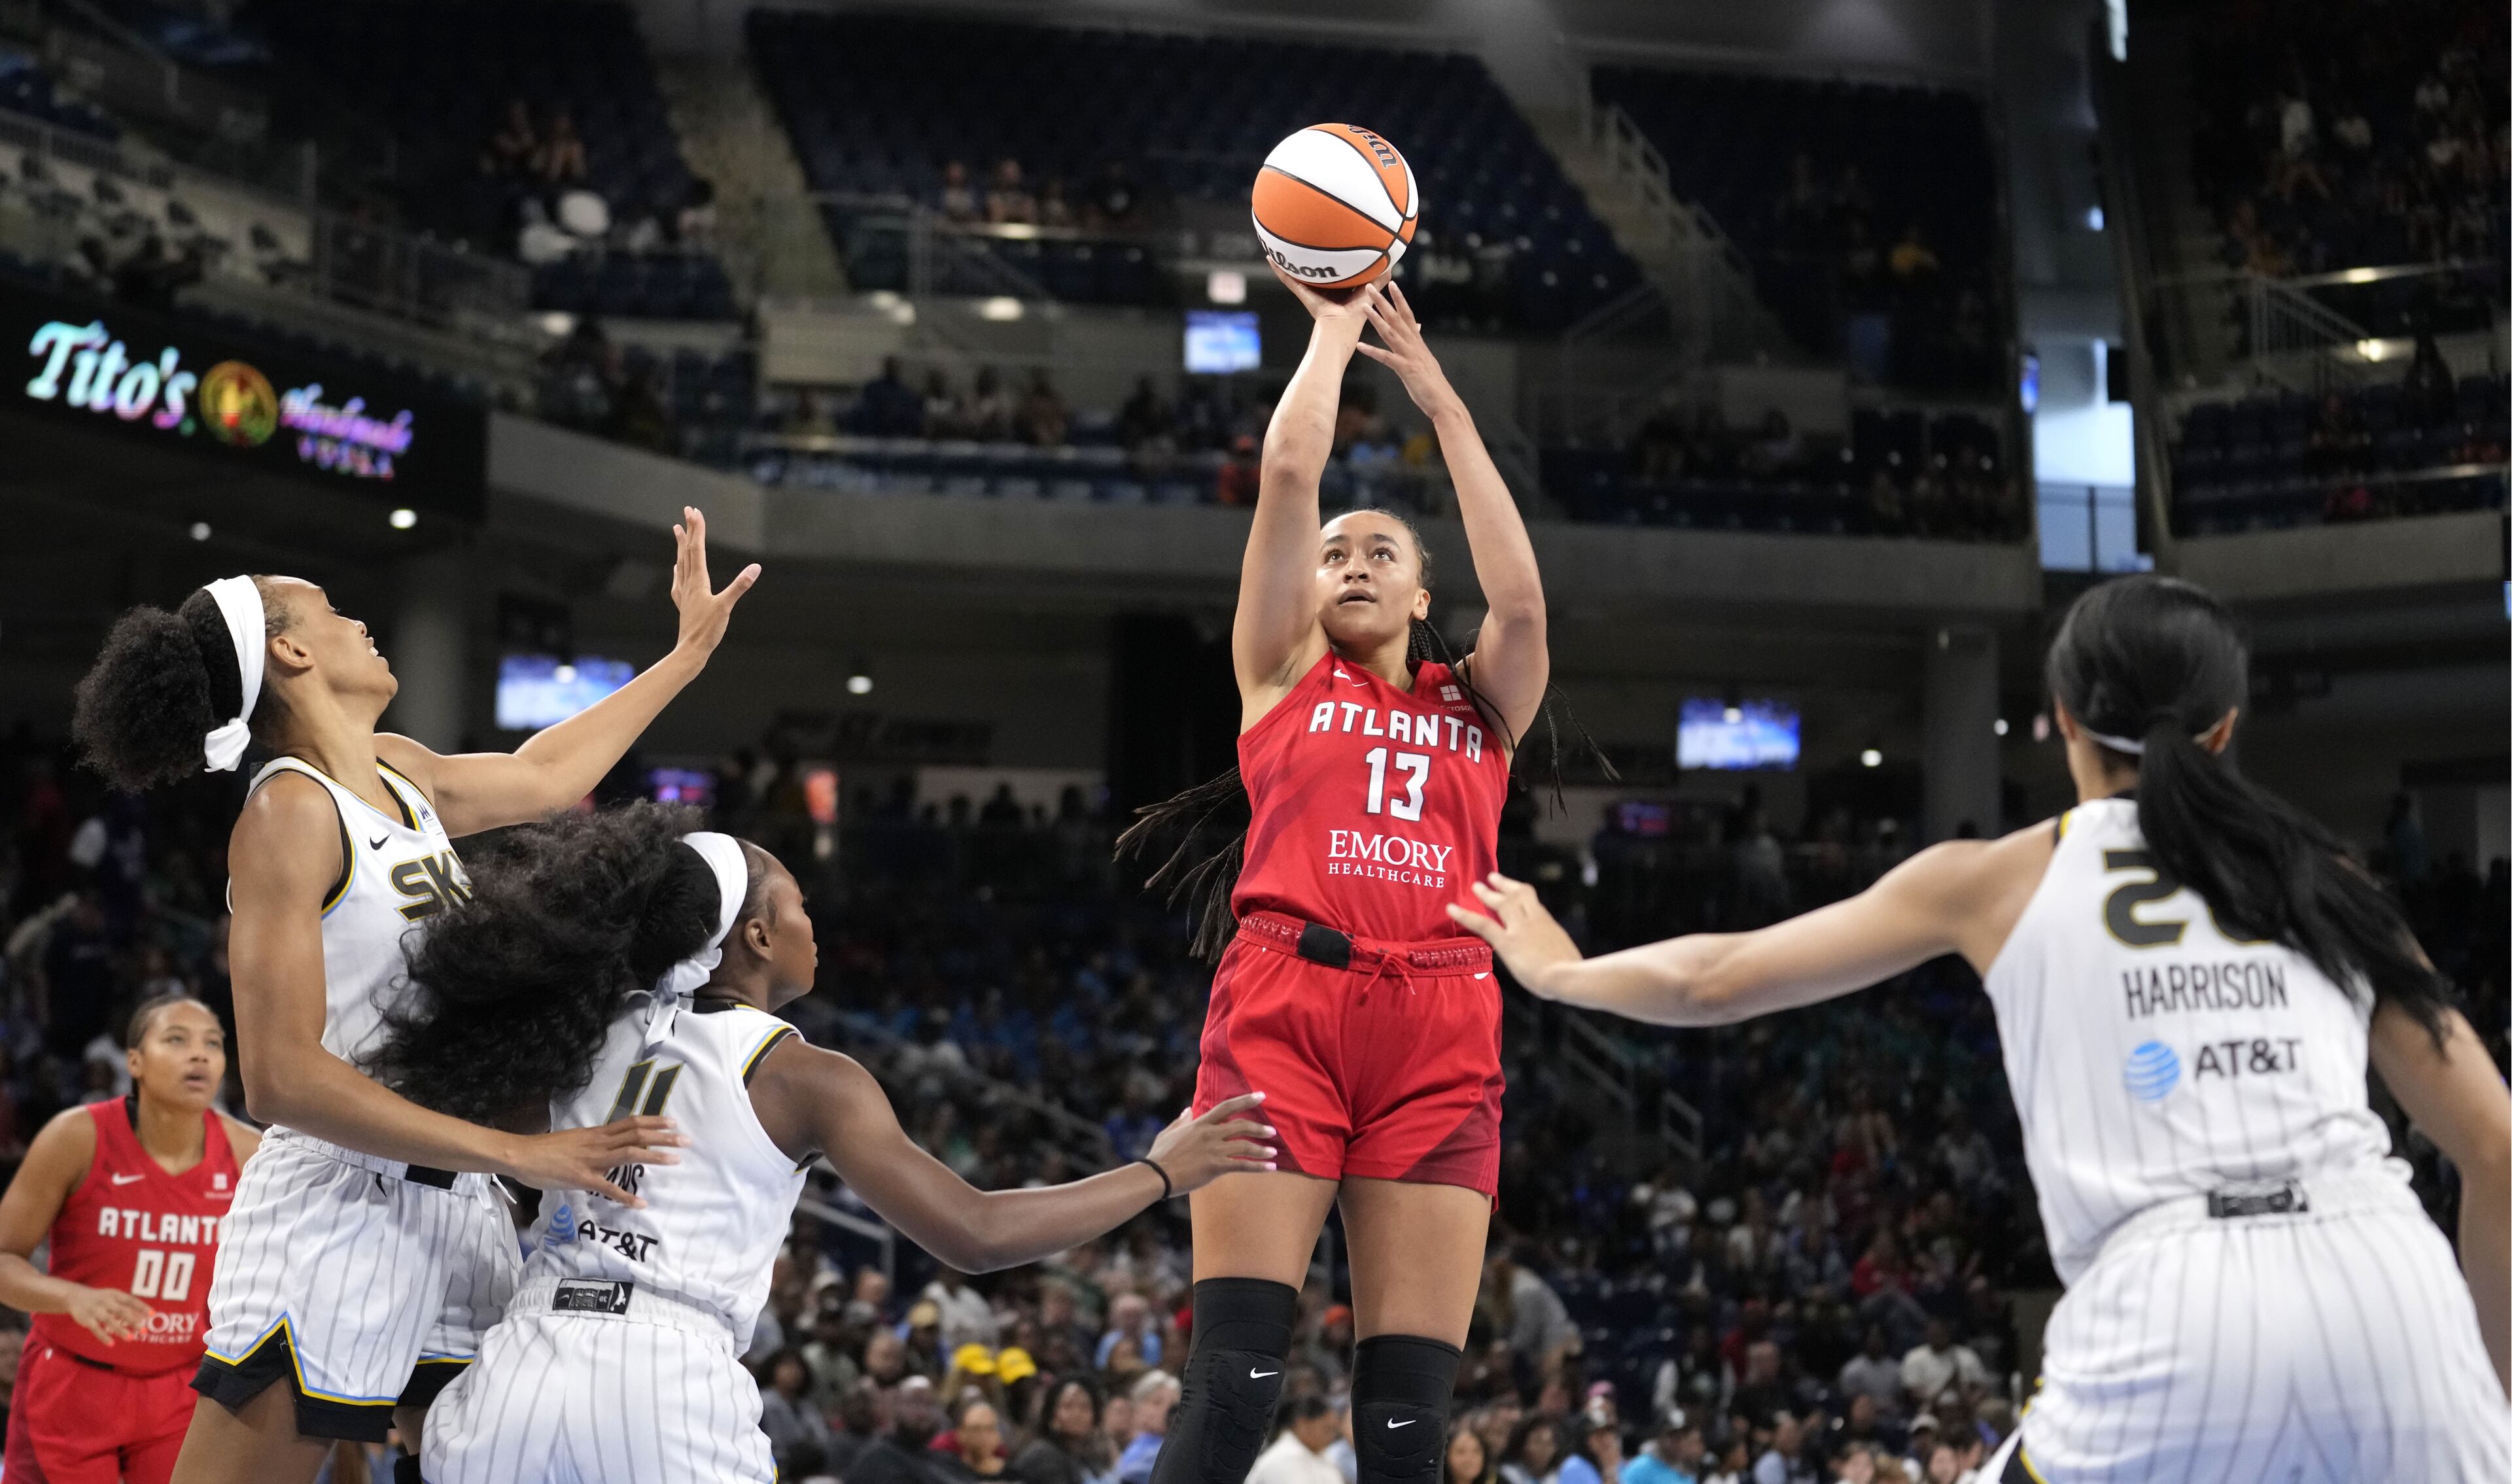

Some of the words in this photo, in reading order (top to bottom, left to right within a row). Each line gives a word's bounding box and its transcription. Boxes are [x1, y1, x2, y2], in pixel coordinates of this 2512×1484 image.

[26, 319, 198, 430] Tito's
[1308, 700, 1483, 764] ATLANTA
[1365, 747, 1430, 822] 13
[1328, 829, 1453, 873] EMORY
[1328, 863, 1445, 889] HEALTHCARE
[389, 849, 473, 924] SK
[2103, 848, 2275, 949] 2
[2121, 961, 2290, 1019] HARRISON
[2195, 1038, 2303, 1082] AT&T
[578, 1220, 659, 1263] AT&T
[131, 1249, 196, 1301] 00
[145, 1311, 200, 1334] ORY
